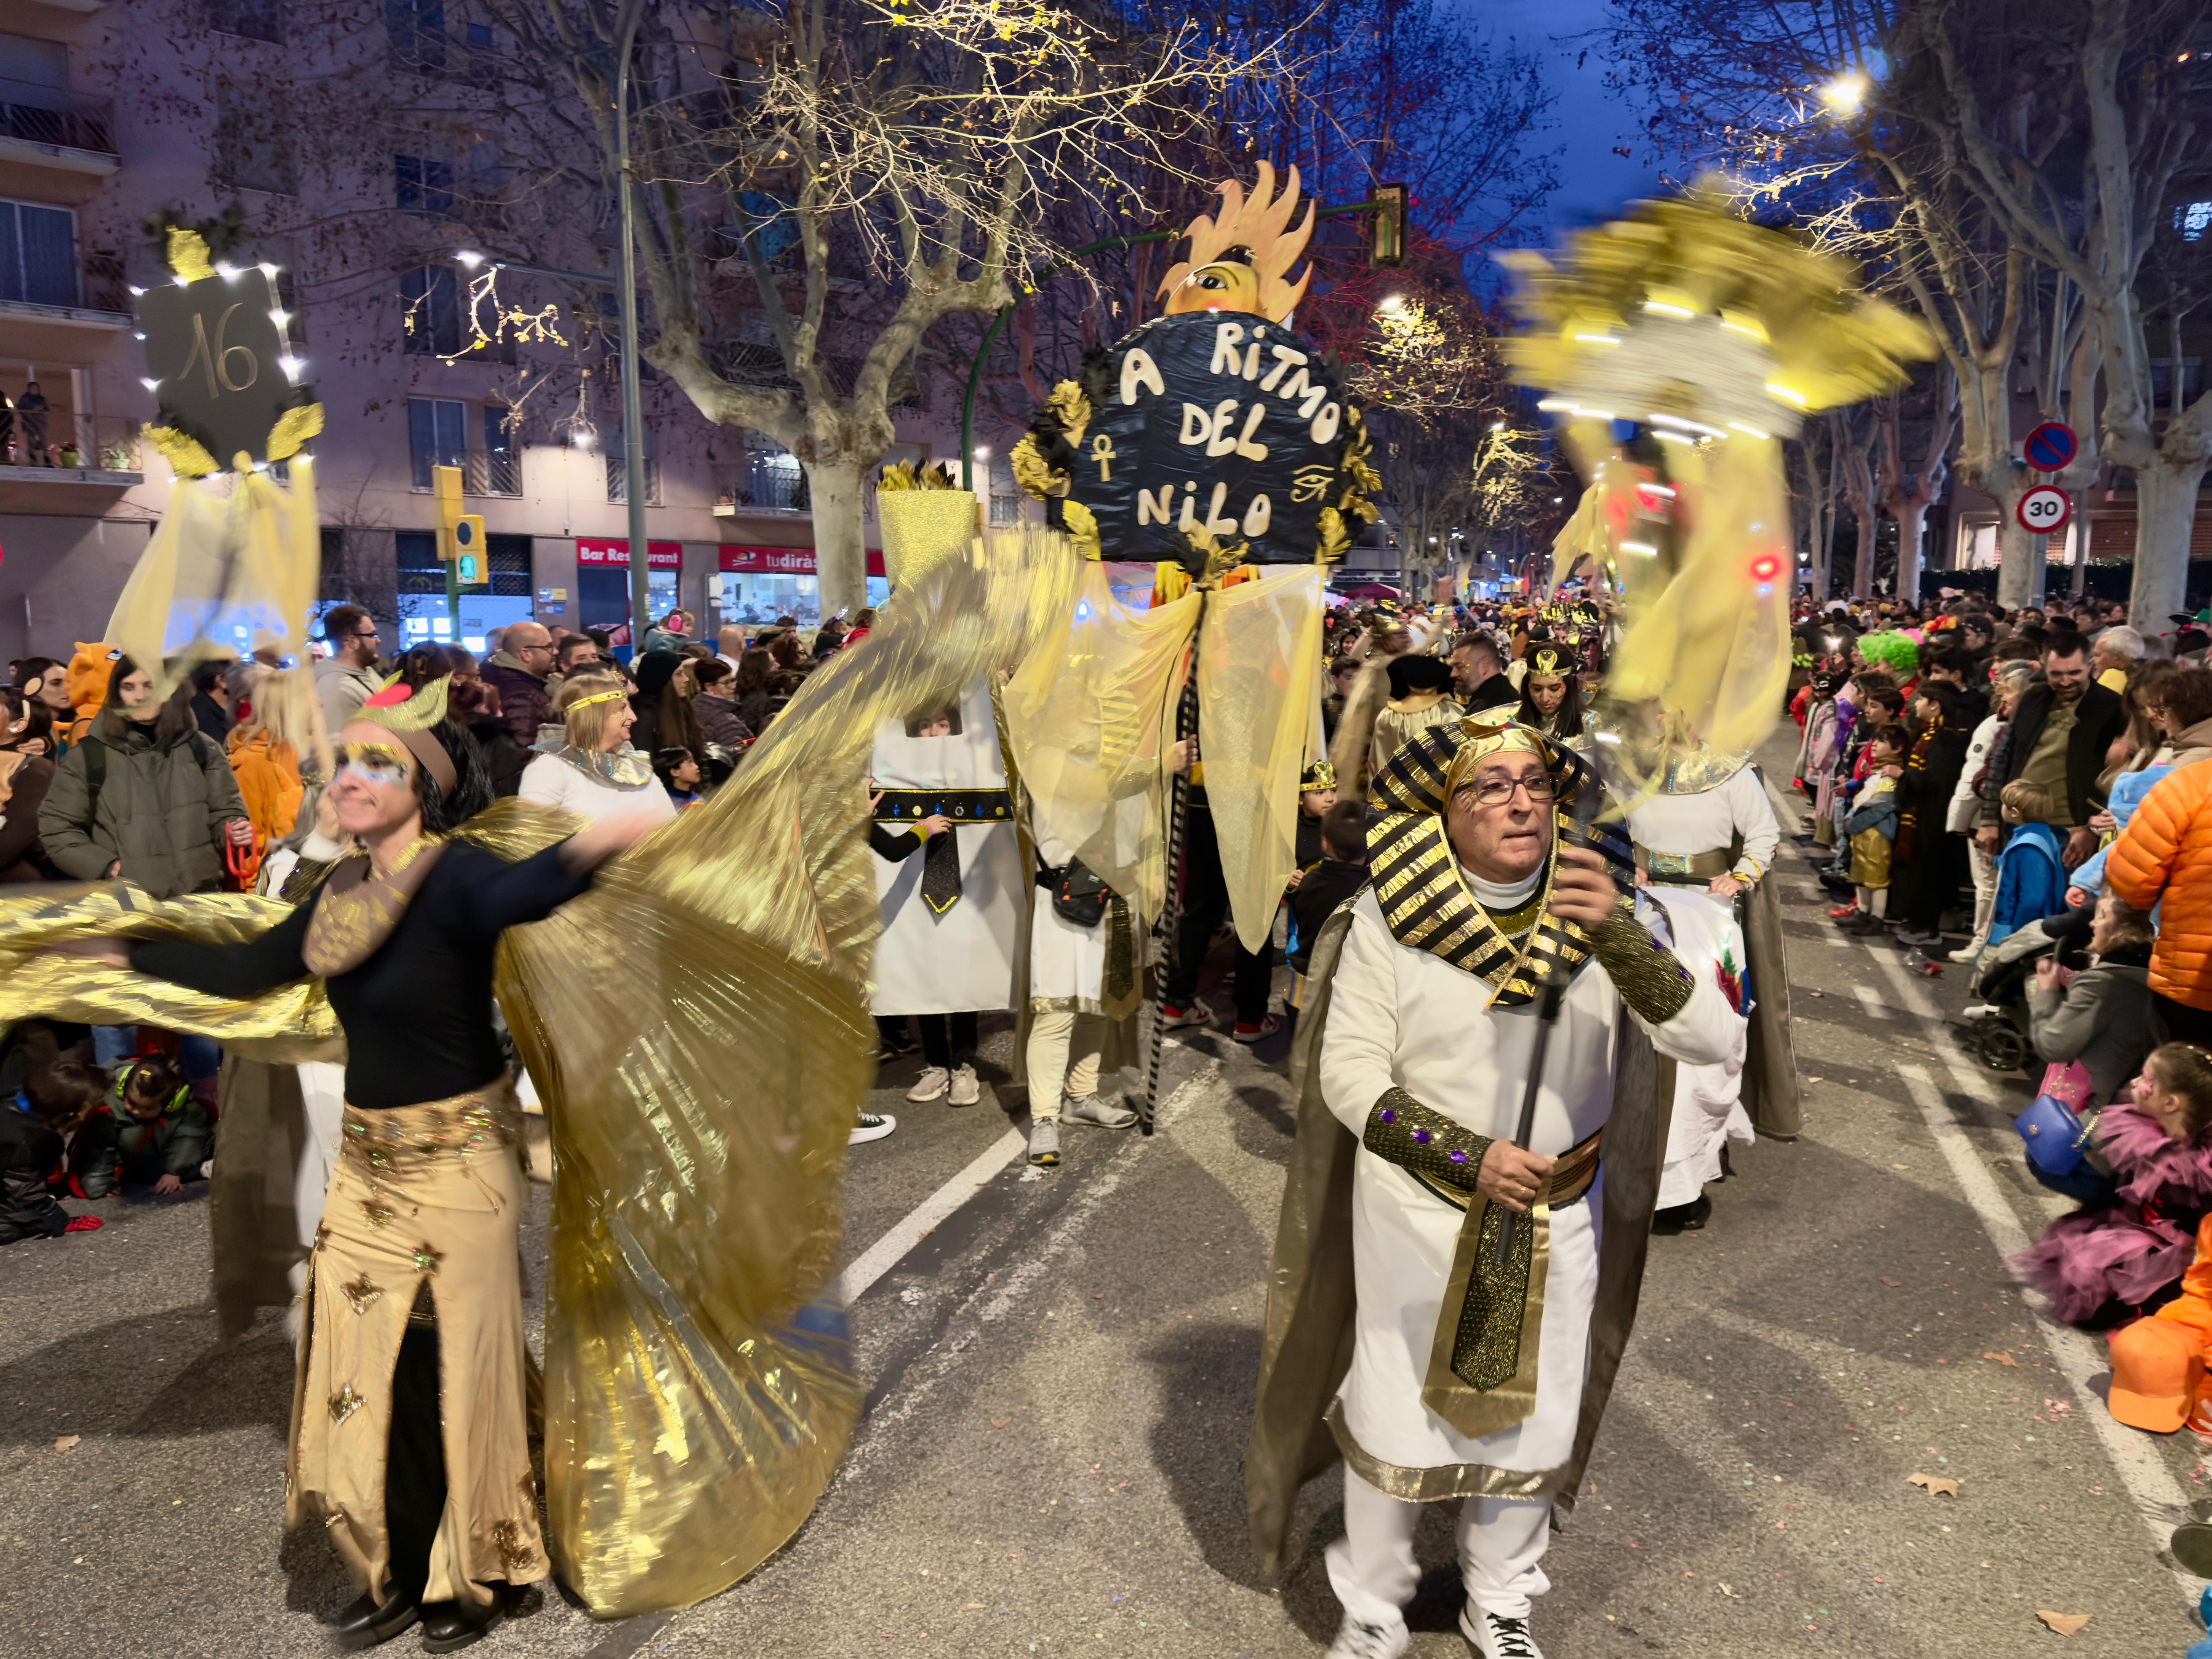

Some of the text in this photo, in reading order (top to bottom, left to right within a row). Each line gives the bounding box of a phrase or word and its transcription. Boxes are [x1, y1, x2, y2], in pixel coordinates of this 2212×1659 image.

[177, 302, 258, 400] 16
[1120, 348, 1165, 406] A
[1178, 399, 1268, 462] DEL
[2030, 501, 2058, 517] 30
[580, 547, 678, 563] Bar Resurant
